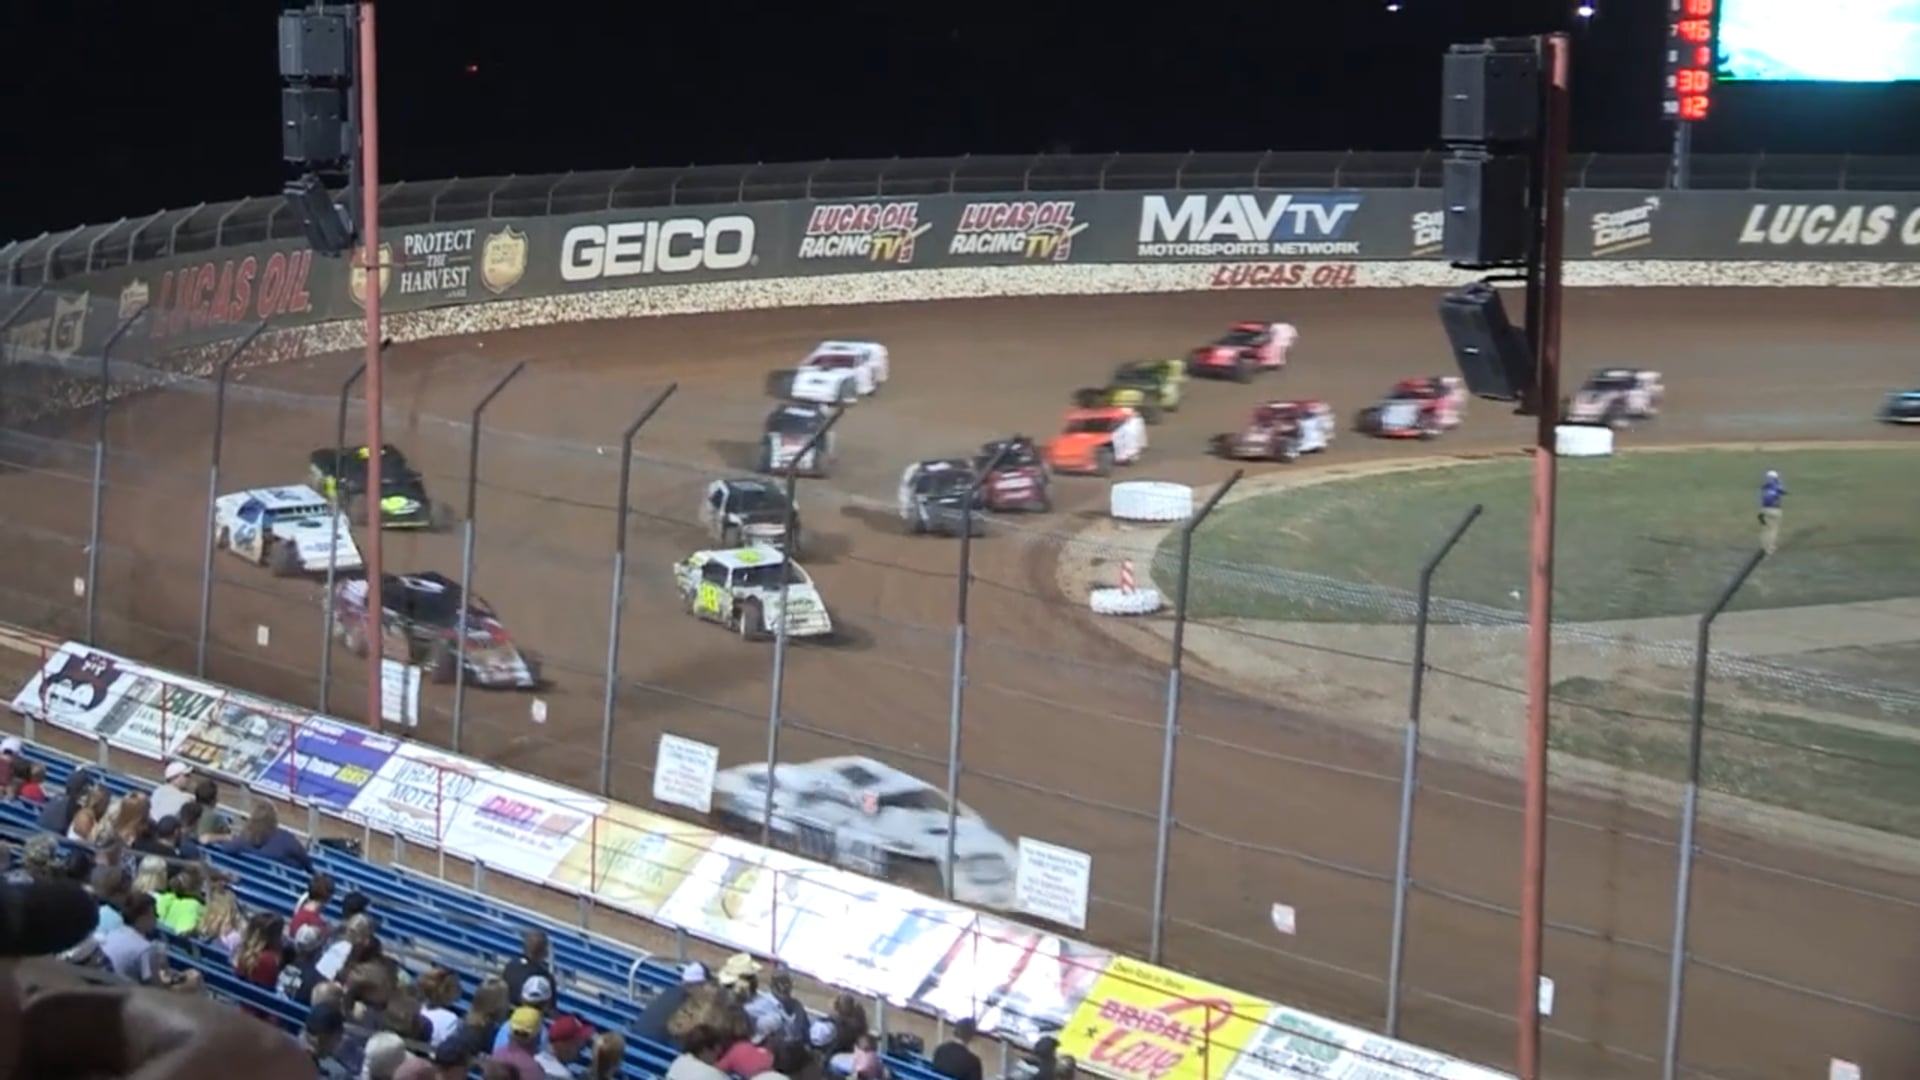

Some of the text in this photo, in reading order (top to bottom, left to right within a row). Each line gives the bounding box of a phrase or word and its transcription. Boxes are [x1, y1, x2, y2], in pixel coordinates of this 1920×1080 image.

[1678, 69, 1710, 93] 30
[1681, 96, 1709, 118] 12
[806, 202, 919, 236] LUCAS OIL
[957, 201, 1075, 232] LUCAS OIL
[1738, 203, 1897, 246] LUCAS
[404, 228, 475, 255] PROTECT
[560, 215, 756, 281] GEICO
[798, 235, 872, 258] RACING
[949, 232, 1027, 255] RACING
[1138, 241, 1360, 257] MOTORSPORTS NETWORK
[426, 254, 448, 267] THE
[400, 266, 471, 294] HARVEST
[1211, 264, 1358, 287] LUCAS OIL
[152, 256, 257, 337] LUCAS
[257, 249, 313, 318] OIL
[1099, 999, 1194, 1046] BRIDAL
